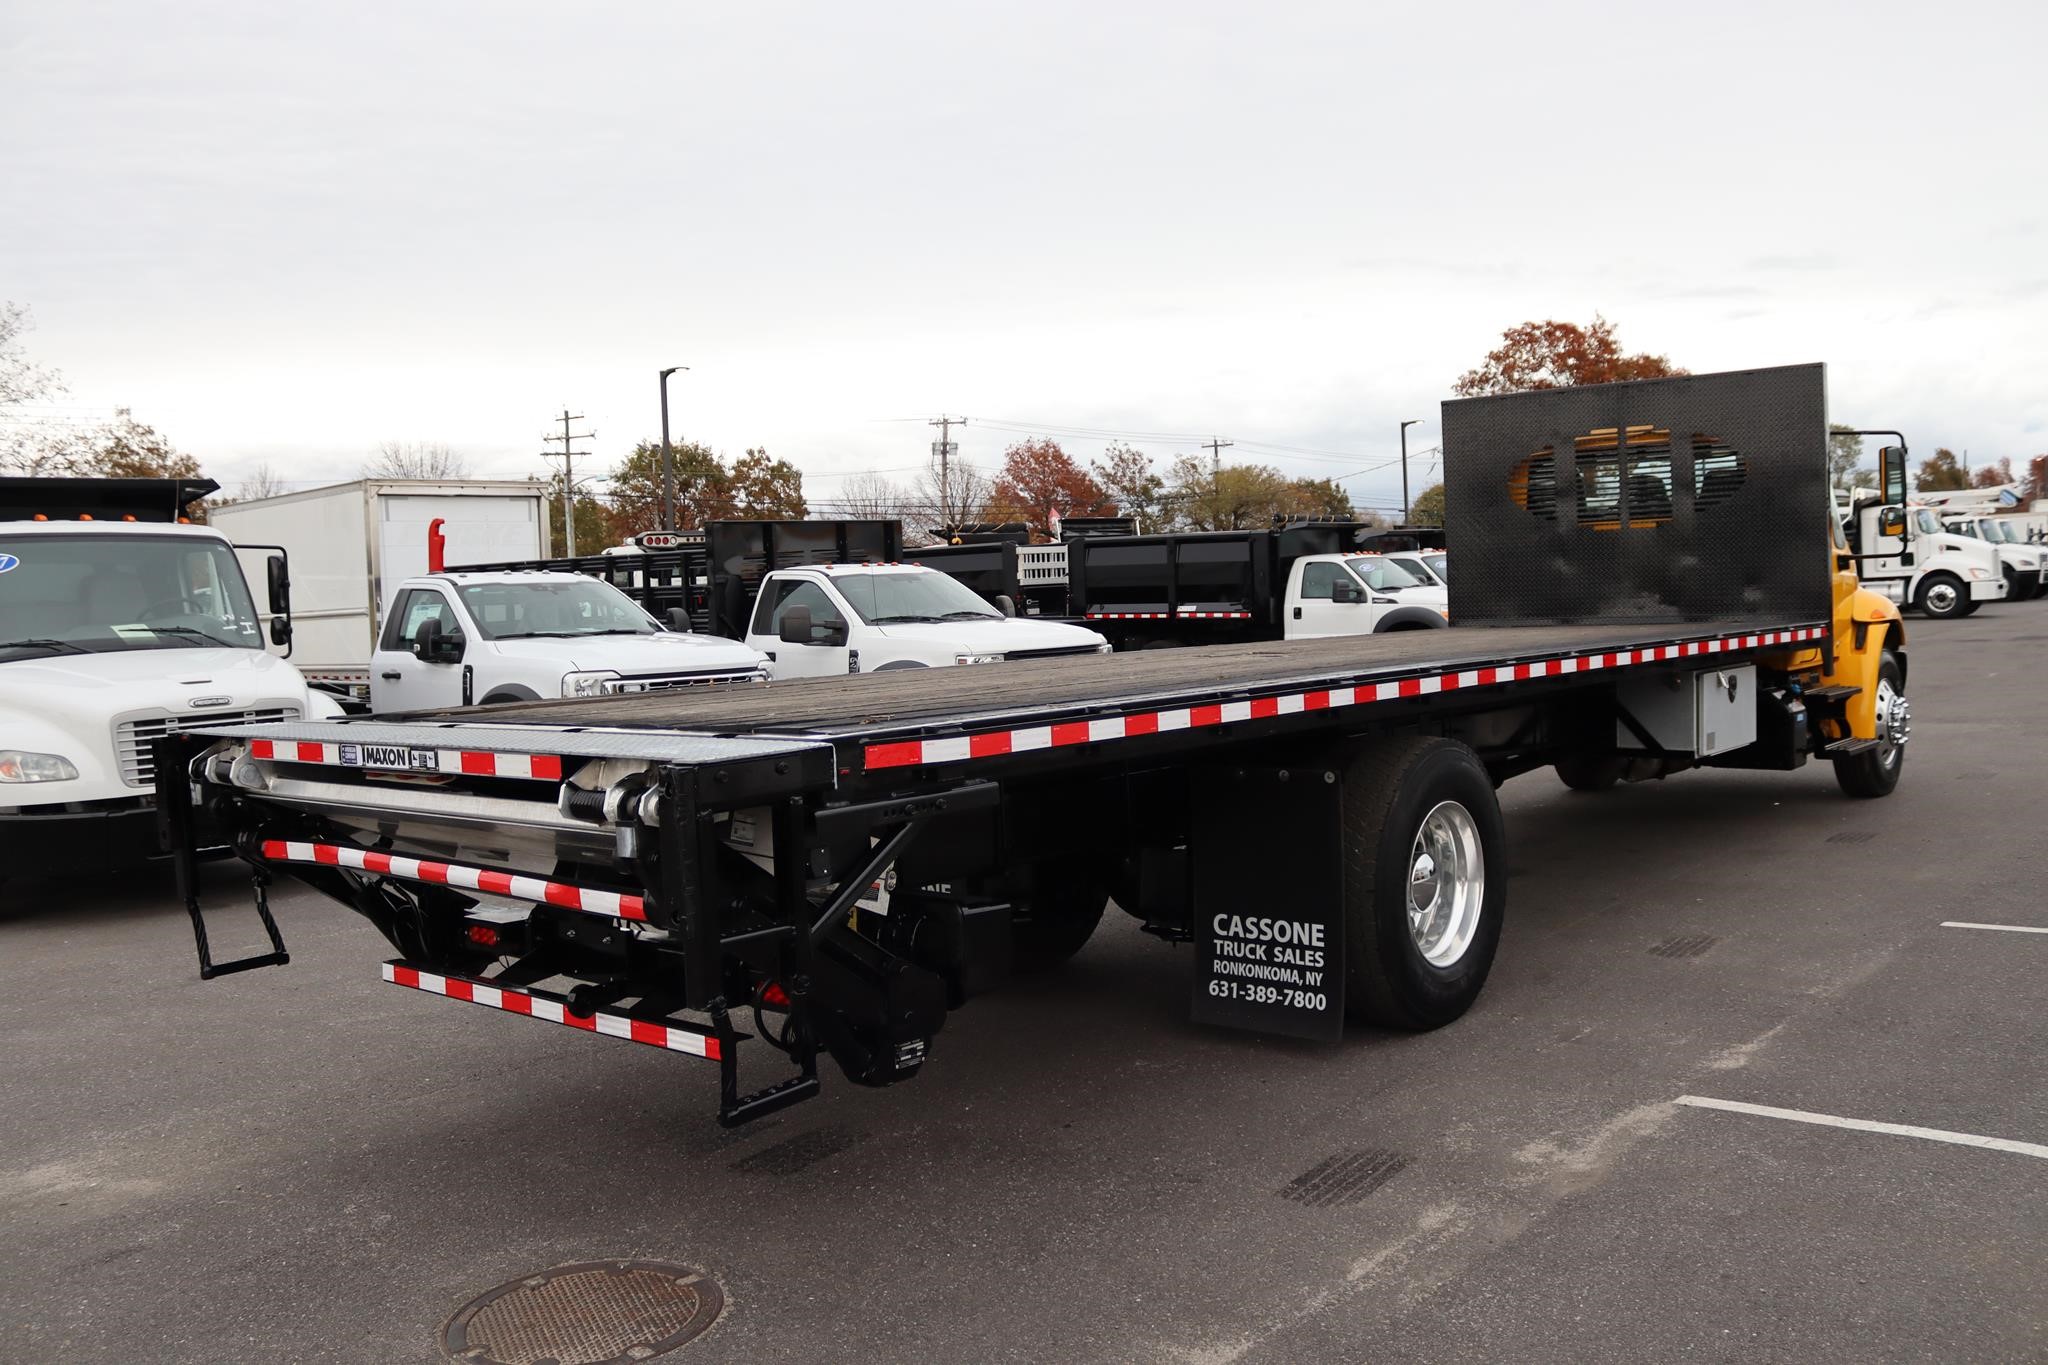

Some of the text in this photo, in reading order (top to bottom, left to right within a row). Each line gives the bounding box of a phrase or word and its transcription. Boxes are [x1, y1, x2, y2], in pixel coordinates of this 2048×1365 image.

[366, 747, 406, 766] MAXON
[1213, 913, 1325, 948] CASSONE
[1213, 939, 1325, 968] TRUCK SALES
[1213, 959, 1323, 987] RONKONKOMA, NY
[1208, 980, 1327, 1011] 631-389-7800
